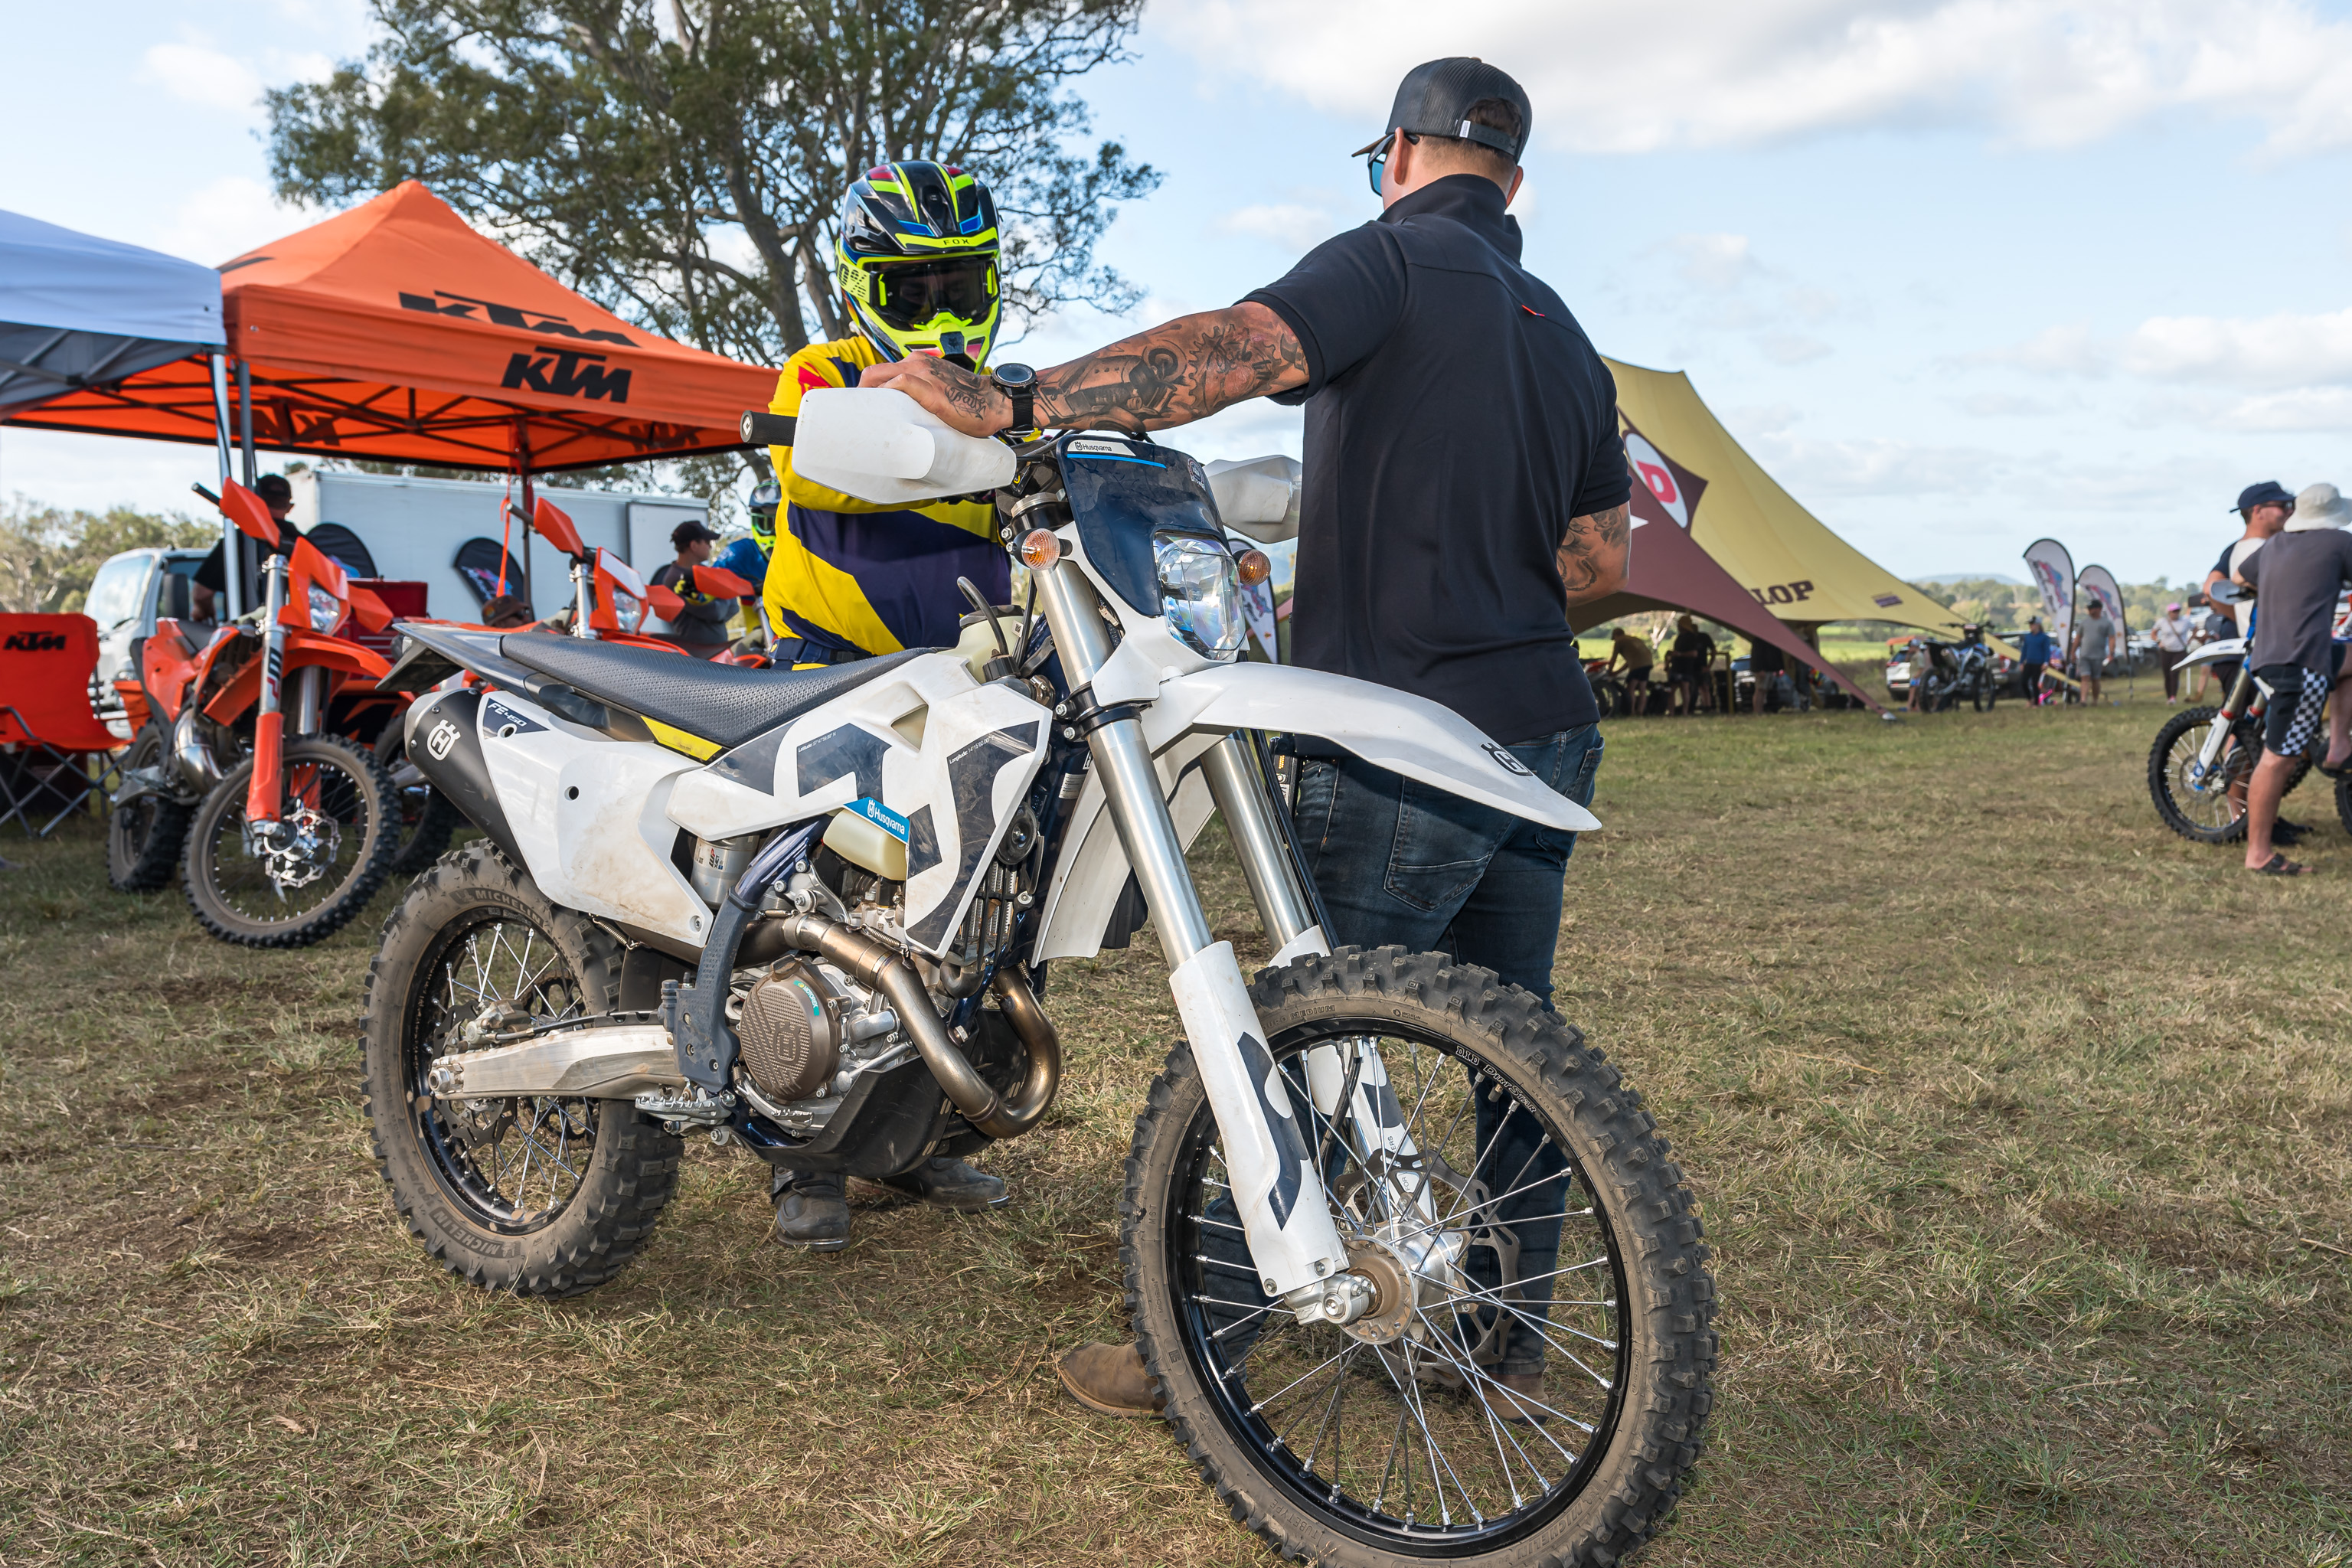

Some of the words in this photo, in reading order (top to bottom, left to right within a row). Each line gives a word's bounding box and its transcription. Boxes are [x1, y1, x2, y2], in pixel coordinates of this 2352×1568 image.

[500, 346, 632, 403] KTM
[1083, 443, 1112, 452] Husqvarna
[3, 631, 67, 652] KTM
[949, 750, 968, 764] Longitude:
[874, 807, 905, 835] Husqvarna
[475, 889, 544, 925] MICHELIN
[803, 985, 818, 1008] MOTOREX
[1289, 1004, 1336, 1021] MEDIUM
[1455, 1045, 1480, 1066] D.I.D
[434, 1210, 502, 1255] MICHELIN
[1205, 1423, 1219, 1441] FRONT
[1269, 1498, 1318, 1540] TUBETYPE
[1517, 1502, 1583, 1560] MICHELIN
